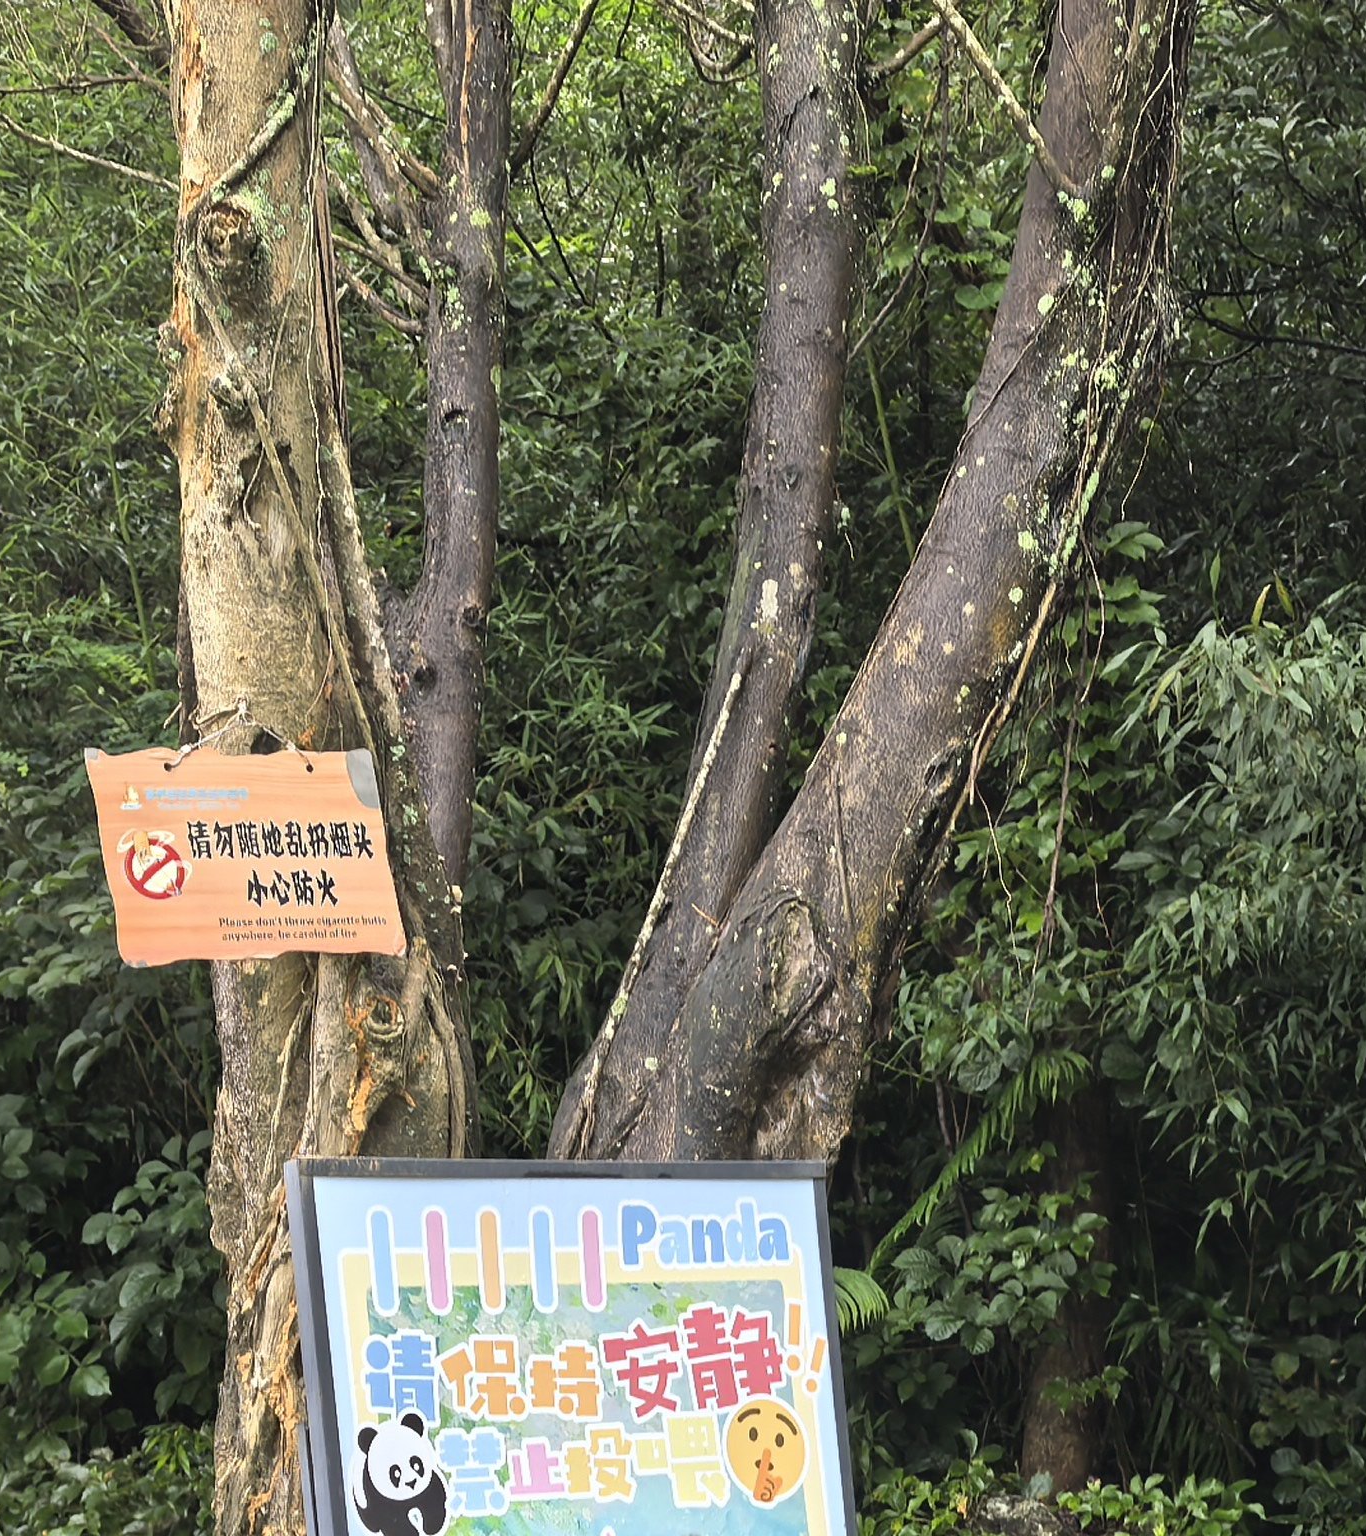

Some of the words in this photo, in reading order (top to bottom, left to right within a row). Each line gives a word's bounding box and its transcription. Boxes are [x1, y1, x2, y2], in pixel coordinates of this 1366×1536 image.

[187, 820, 374, 860] 请勿随地乱扔烟头
[247, 868, 338, 907] 小心防火
[219, 917, 253, 928] Please
[255, 916, 282, 926] don't
[285, 915, 314, 926] throw
[317, 915, 360, 928] cigarette
[620, 1202, 790, 1266] Panda
[439, 1417, 727, 1511] 禁止投喂
